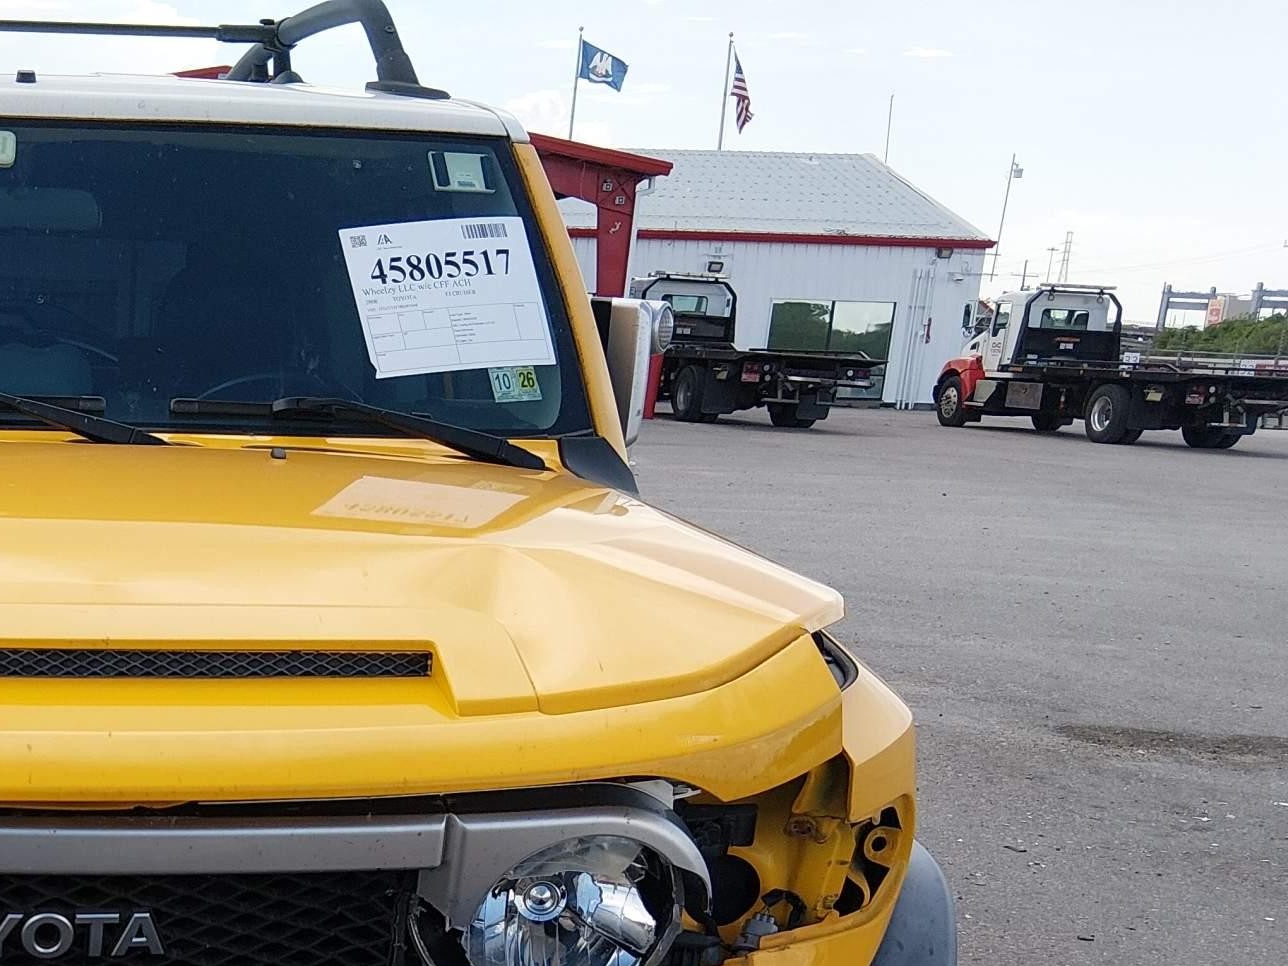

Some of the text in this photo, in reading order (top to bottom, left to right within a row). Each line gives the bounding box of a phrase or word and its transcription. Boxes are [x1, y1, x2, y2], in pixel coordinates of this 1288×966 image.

[370, 248, 510, 285] 45805517
[398, 283, 416, 293] LLC
[452, 278, 472, 287] ACH
[494, 373, 511, 391] 10
[518, 371, 535, 389] 26
